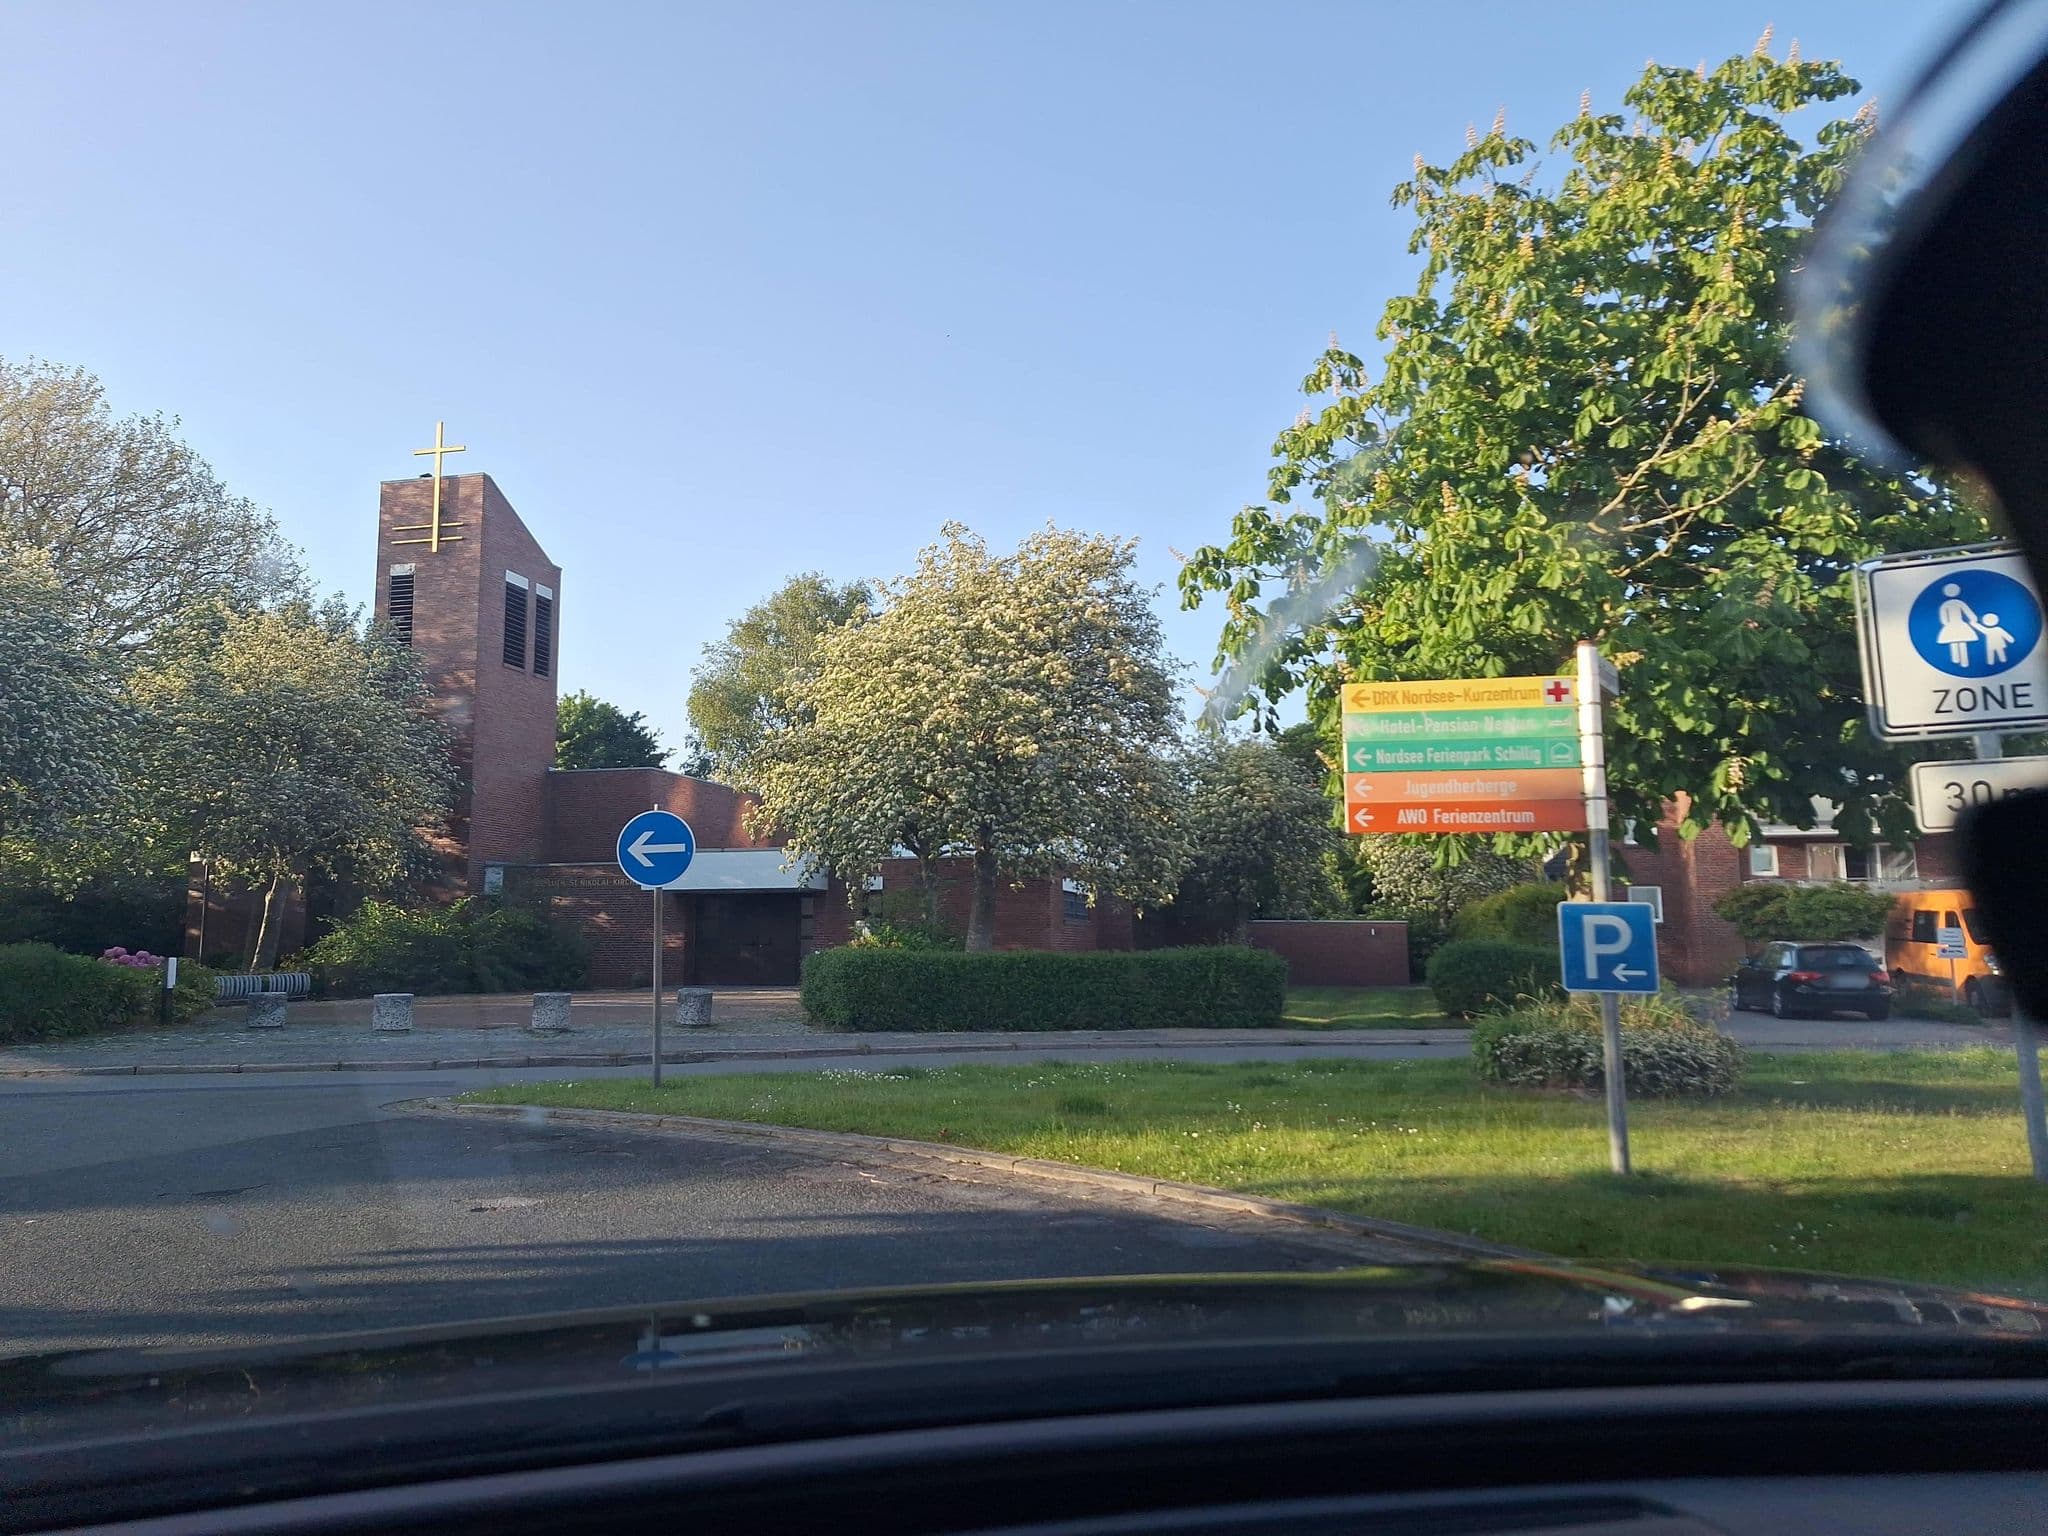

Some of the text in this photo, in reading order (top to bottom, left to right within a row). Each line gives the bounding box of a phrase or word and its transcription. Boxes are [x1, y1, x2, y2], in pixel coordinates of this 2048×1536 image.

[1372, 687, 1541, 706] DRK Nordsee-Kurzentrum
[1932, 682, 2034, 714] ZONE
[1376, 745, 1542, 766] Nordsee Ferienpark Schillig
[1404, 779, 1518, 798] Jugendherberge
[1396, 807, 1536, 825] AWO Ferienzentrum
[1582, 914, 1633, 979] P
